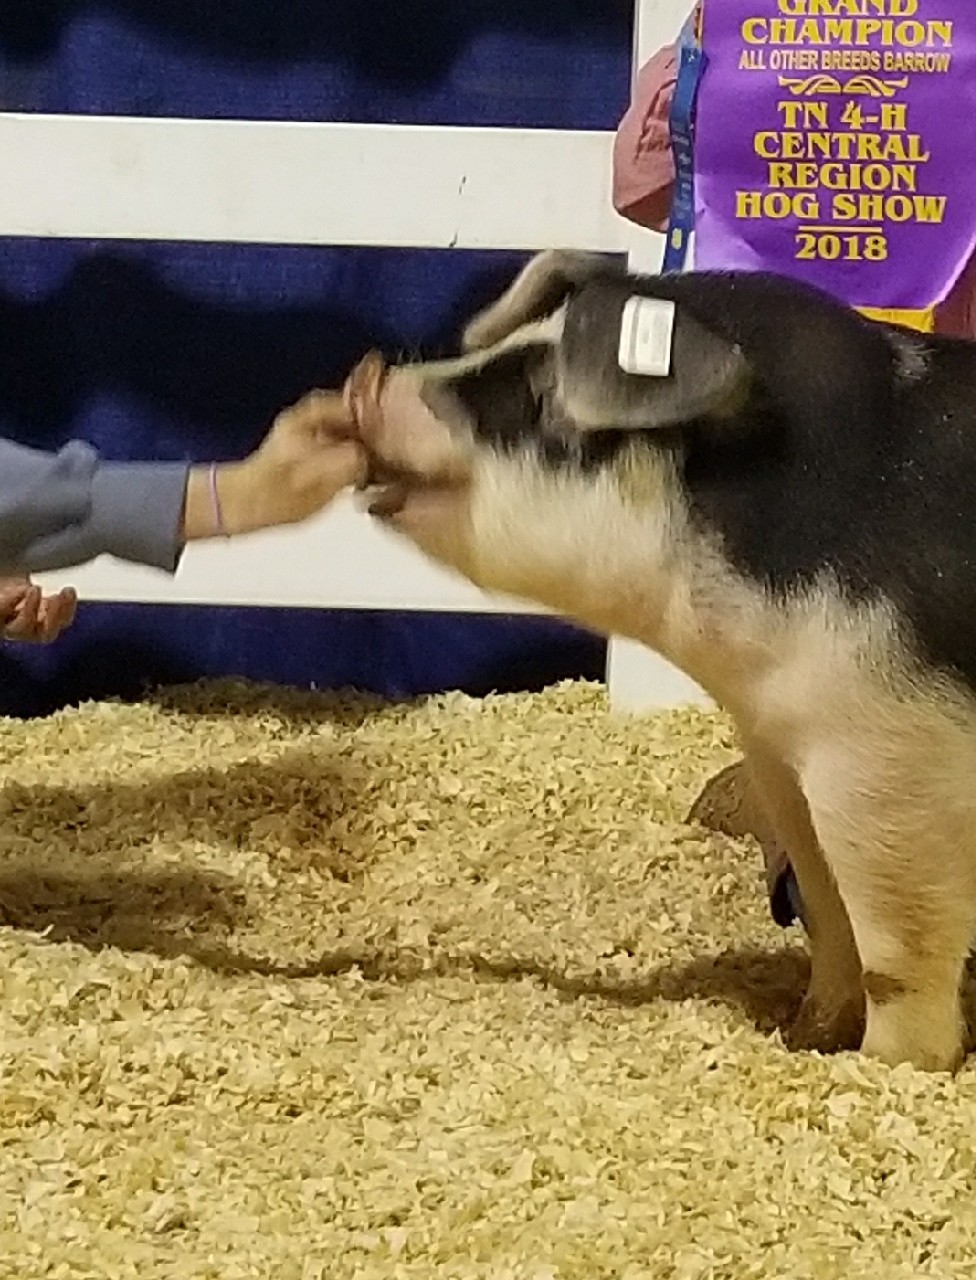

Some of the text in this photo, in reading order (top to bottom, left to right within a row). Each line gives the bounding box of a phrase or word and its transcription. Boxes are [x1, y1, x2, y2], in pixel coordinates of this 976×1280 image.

[740, 18, 954, 48] CHAMPION
[738, 49, 951, 73] ALL OTHER BREEDS BARROW
[777, 101, 907, 131] TN 4-H
[753, 131, 931, 162] CENTRAL
[767, 163, 918, 192] REGION
[735, 190, 948, 224] HOG SHOW
[794, 233, 889, 261] 2018
